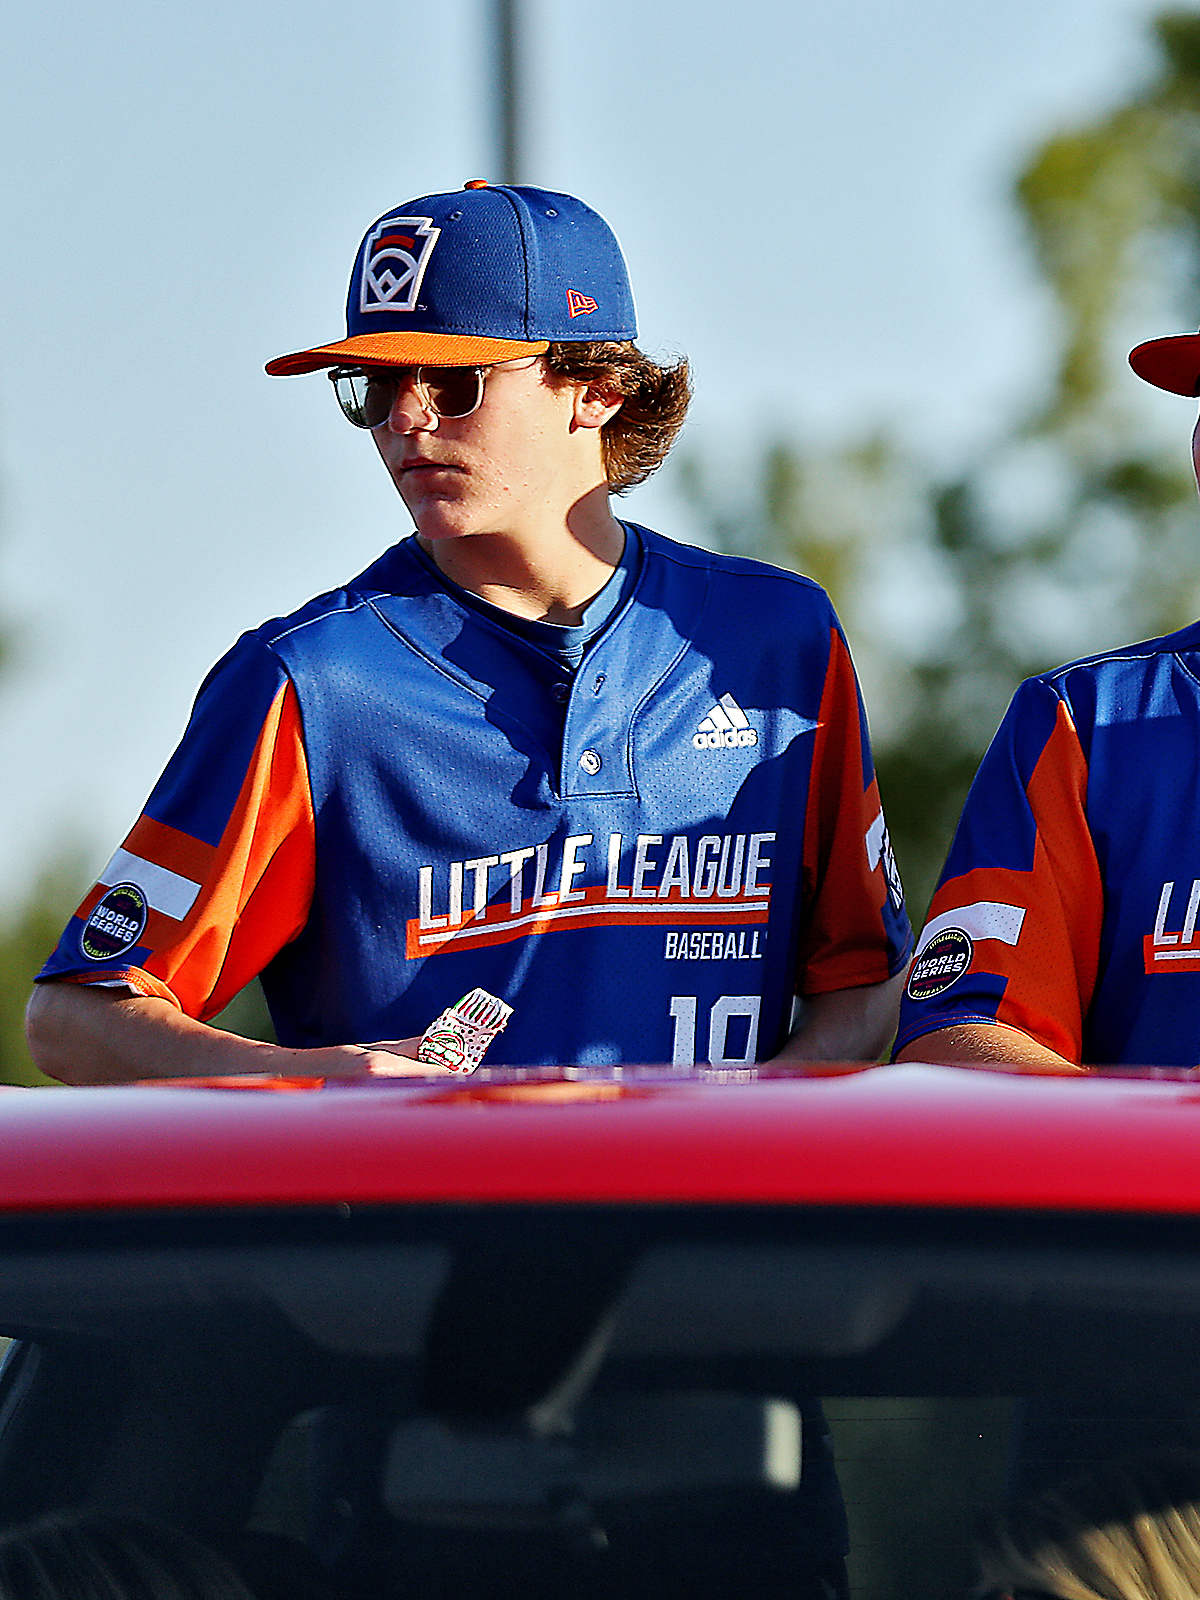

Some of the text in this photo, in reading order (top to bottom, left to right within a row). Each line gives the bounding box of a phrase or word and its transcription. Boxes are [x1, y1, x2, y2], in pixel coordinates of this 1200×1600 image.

[692, 727, 758, 750] adidas
[418, 832, 777, 930] LITTLE LEAGUE
[89, 915, 134, 942] SERIES
[95, 905, 140, 932] WORLD
[664, 931, 762, 960] BASEBALL
[912, 963, 963, 982] SERIES
[918, 953, 965, 971] WORLD
